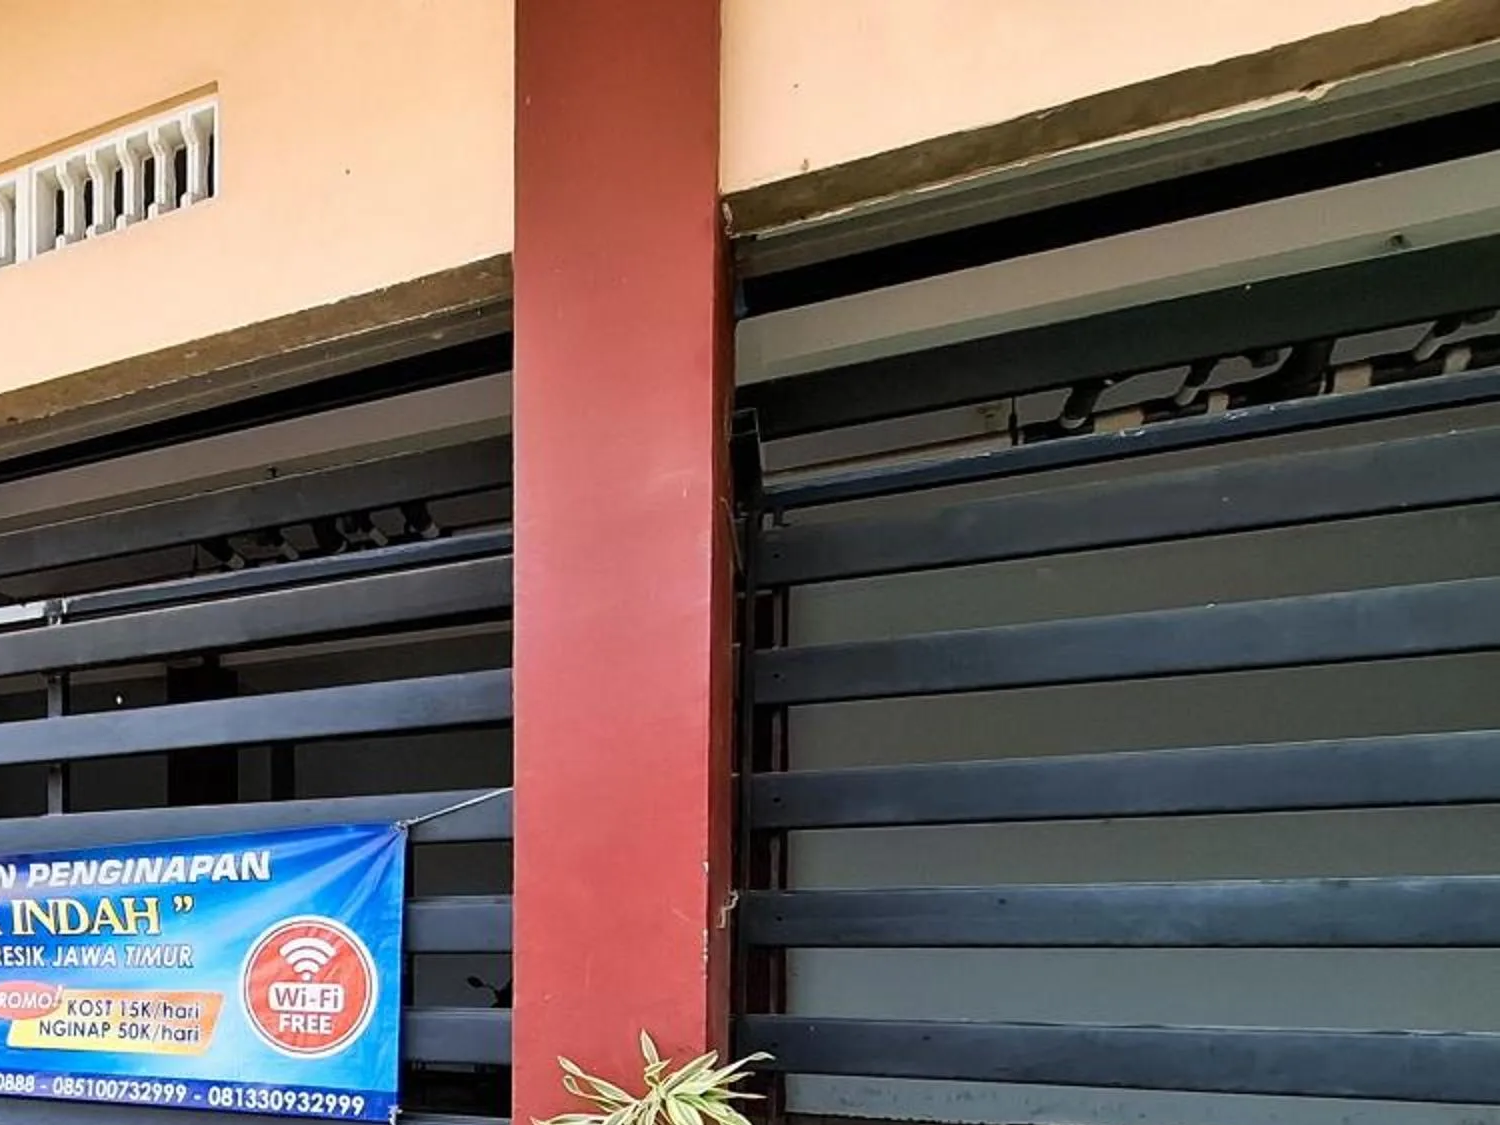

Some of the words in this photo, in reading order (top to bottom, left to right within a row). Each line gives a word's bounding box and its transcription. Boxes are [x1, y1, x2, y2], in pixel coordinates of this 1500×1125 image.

[27, 850, 273, 888] PENGINAPAN
[12, 896, 162, 936] INDAH
[52, 944, 117, 968] JAWA
[124, 943, 194, 968] TIMUR
[274, 986, 339, 1009] Wi-Fi
[67, 999, 112, 1018] KOST
[119, 1000, 200, 1021] 15K/hari
[39, 1020, 111, 1039] NGINAP
[118, 1022, 200, 1043] 50K/hari
[278, 1013, 333, 1035] FREE
[52, 1076, 188, 1104] 085100732999
[207, 1085, 365, 1117] 081330932999
